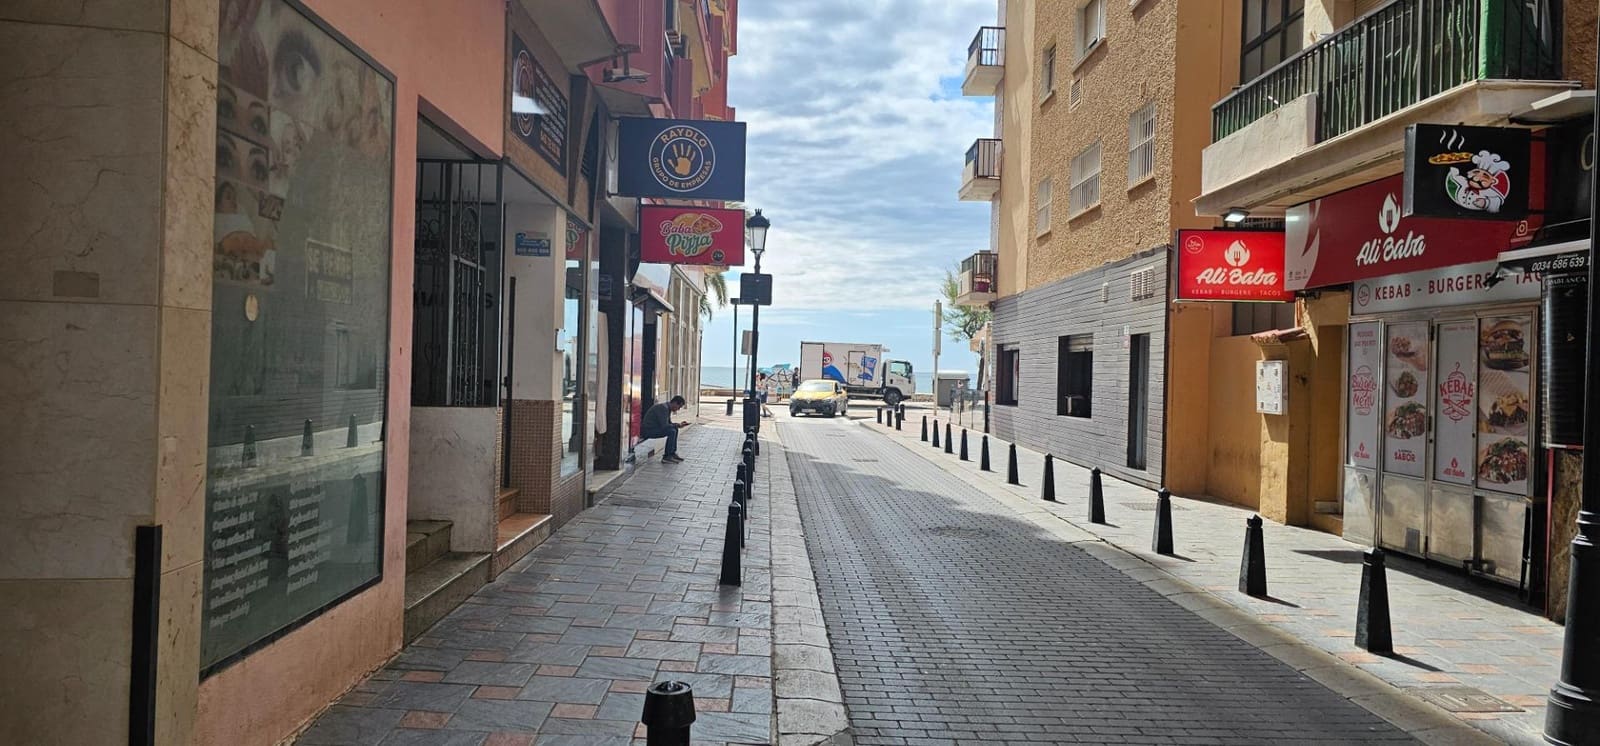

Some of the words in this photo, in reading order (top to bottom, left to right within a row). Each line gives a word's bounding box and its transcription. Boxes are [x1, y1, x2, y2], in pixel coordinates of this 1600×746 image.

[660, 128, 708, 149] RAYDLO
[652, 156, 669, 182] GRUPO
[668, 180, 680, 188] DE
[681, 160, 713, 189] EMPRESAS
[661, 221, 692, 235] Baba
[666, 233, 712, 256] Pizza
[1356, 238, 1381, 267] Ali
[1382, 230, 1426, 262] Baba
[1531, 261, 1552, 272] 0034
[1552, 258, 1568, 270] 686
[1569, 256, 1585, 268] 639
[1195, 267, 1228, 285] Ali
[1228, 267, 1278, 286] Baba
[1375, 283, 1412, 301] KEBAB
[1439, 380, 1474, 398] KEBAB
[1394, 451, 1416, 463] SABOR
